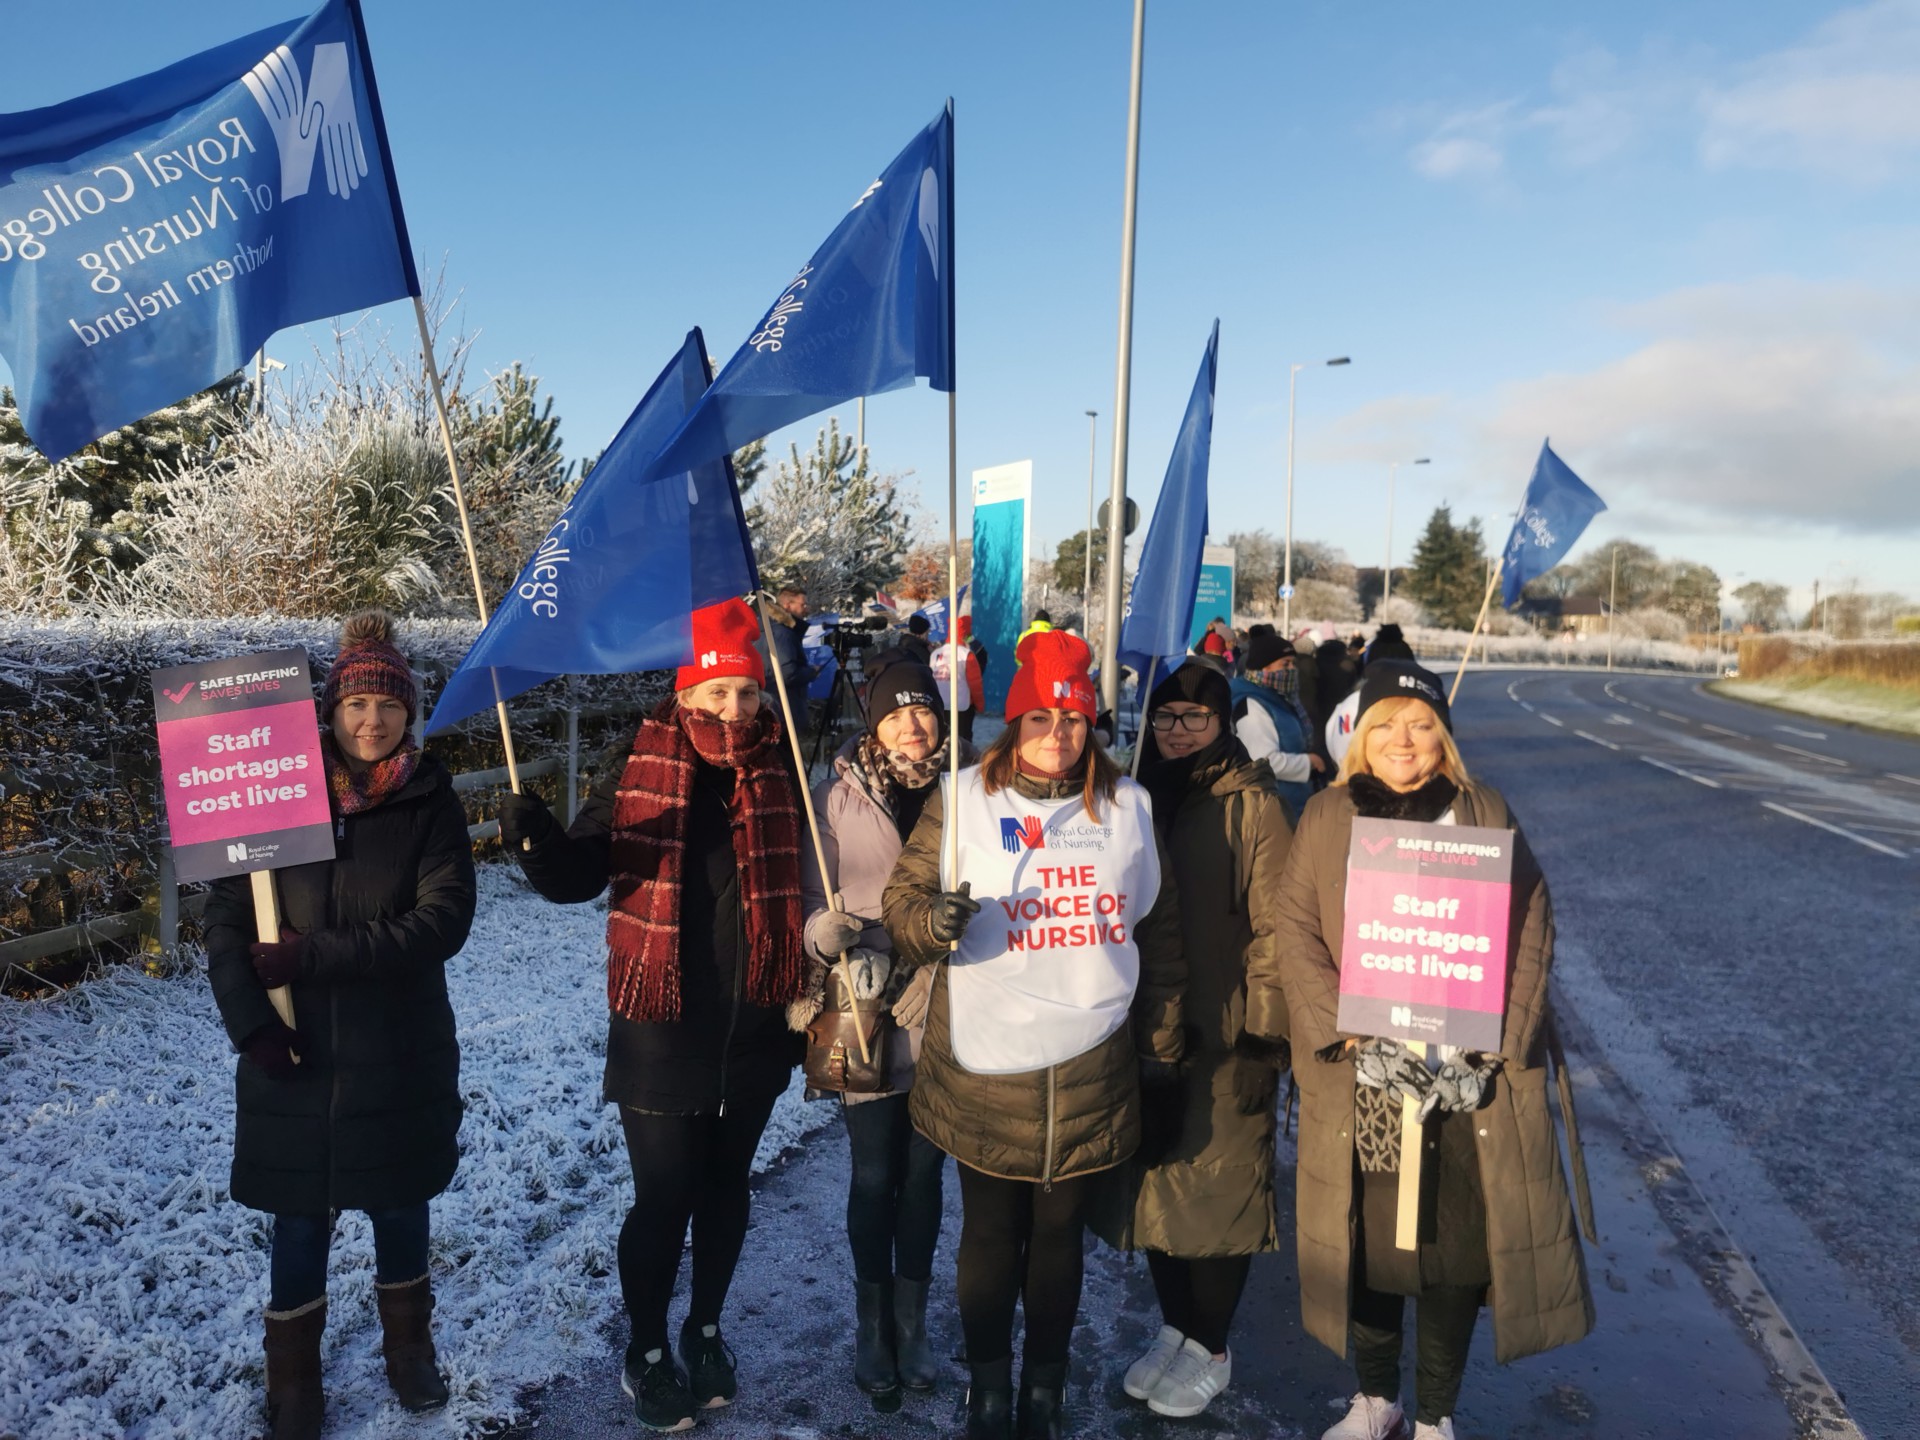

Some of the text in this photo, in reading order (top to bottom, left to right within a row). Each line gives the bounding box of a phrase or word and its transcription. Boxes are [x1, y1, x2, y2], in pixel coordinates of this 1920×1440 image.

[749, 278, 804, 353] College
[518, 518, 571, 619] College
[199, 666, 300, 690] SAFE STAFFING
[201, 680, 281, 701] SAVES LIVES
[207, 726, 271, 754] Staff
[178, 753, 309, 788] shortages
[186, 783, 308, 816] cost lives
[1048, 825, 1114, 839] Royal College
[1050, 839, 1105, 852] of Nursing
[1396, 849, 1478, 866] SAVES LIVES
[1397, 838, 1501, 858] SAFE STAFFING
[1037, 865, 1097, 889] THE
[1001, 893, 1127, 922] VOICE OF
[1392, 894, 1460, 920] Staff
[1007, 923, 1127, 952] NURSING
[1358, 920, 1491, 954] shortages
[1360, 952, 1484, 982] cost lives
